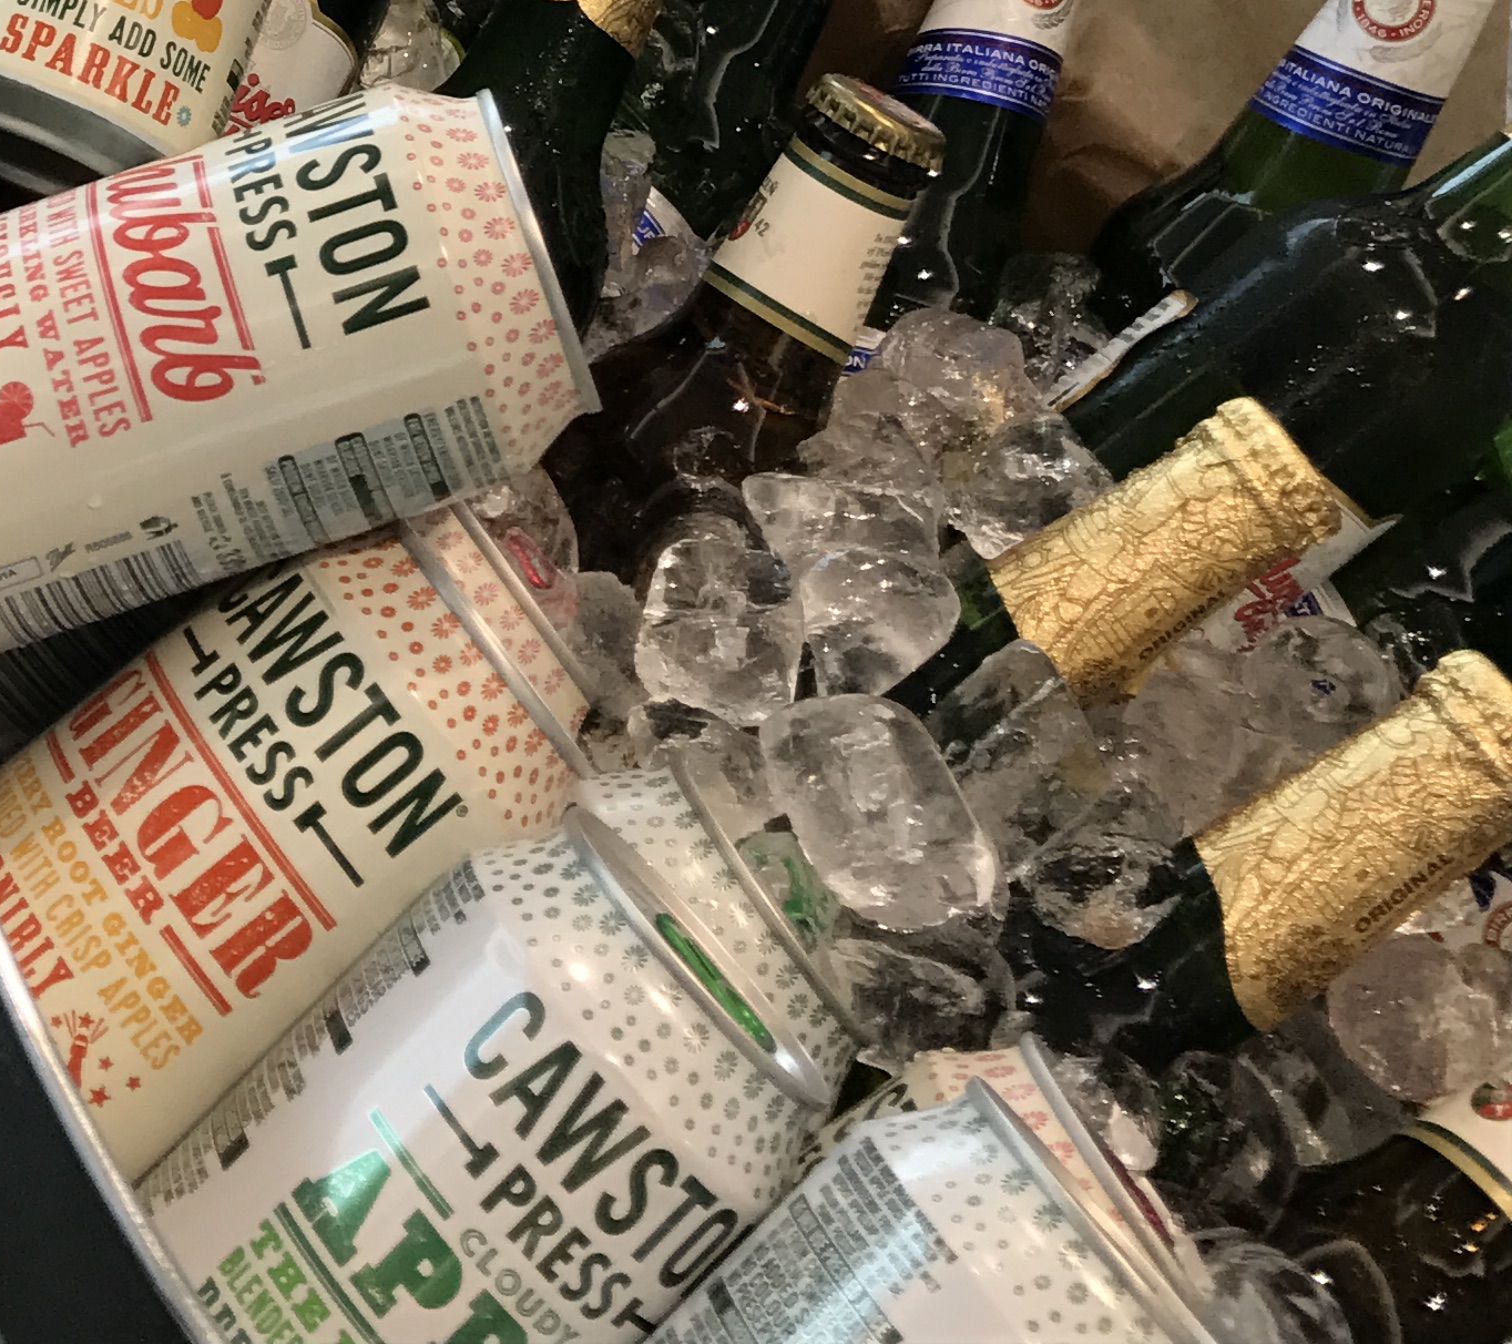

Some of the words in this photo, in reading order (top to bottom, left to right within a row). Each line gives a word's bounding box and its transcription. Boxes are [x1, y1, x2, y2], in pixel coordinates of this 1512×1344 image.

[108, 15, 158, 59] ADD
[159, 40, 211, 94] SOME
[898, 72, 929, 84] TUTTI
[932, 73, 1029, 102] INGREDIENTI
[945, 42, 1026, 66] ITALIANA
[1285, 63, 1352, 99] ITALIANA
[46, 205, 81, 248] WITH
[224, 138, 298, 251] PRESS
[52, 249, 100, 325] SWEET
[36, 309, 90, 448] WATER
[72, 335, 132, 438] APPLES
[193, 662, 315, 812] PRESS
[64, 778, 165, 926] BEER
[69, 668, 314, 1000] GINGER
[41, 815, 109, 907] ROOT
[102, 911, 204, 1046] GINGER
[1354, 853, 1455, 934] ORIGINAL
[10, 831, 62, 900] WITH
[45, 893, 113, 974] CRISP
[96, 976, 182, 1071] APPLES
[249, 1217, 331, 1334] THE
[458, 1227, 580, 1342] CLOUDY
[479, 1163, 633, 1321] PRESS
